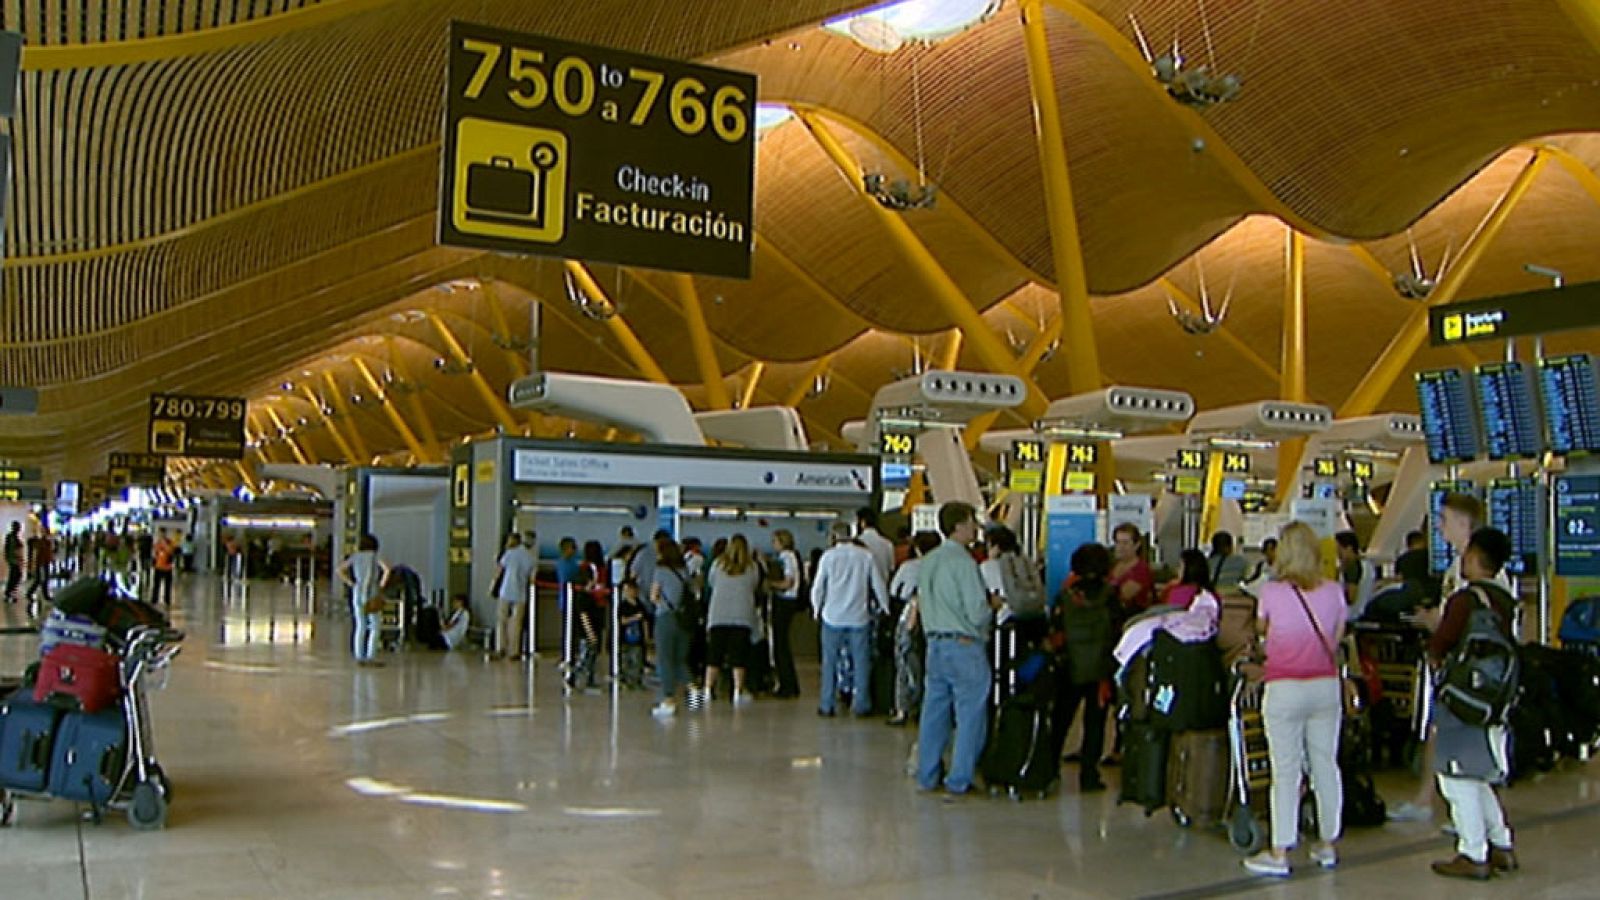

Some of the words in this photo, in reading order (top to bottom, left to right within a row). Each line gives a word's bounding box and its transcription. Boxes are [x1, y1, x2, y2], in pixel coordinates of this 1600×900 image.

[463, 39, 595, 116] 750
[601, 64, 623, 87] to
[602, 101, 618, 121] a
[629, 68, 747, 142] 766
[618, 165, 709, 202] Check-in
[576, 193, 743, 242] Facturación
